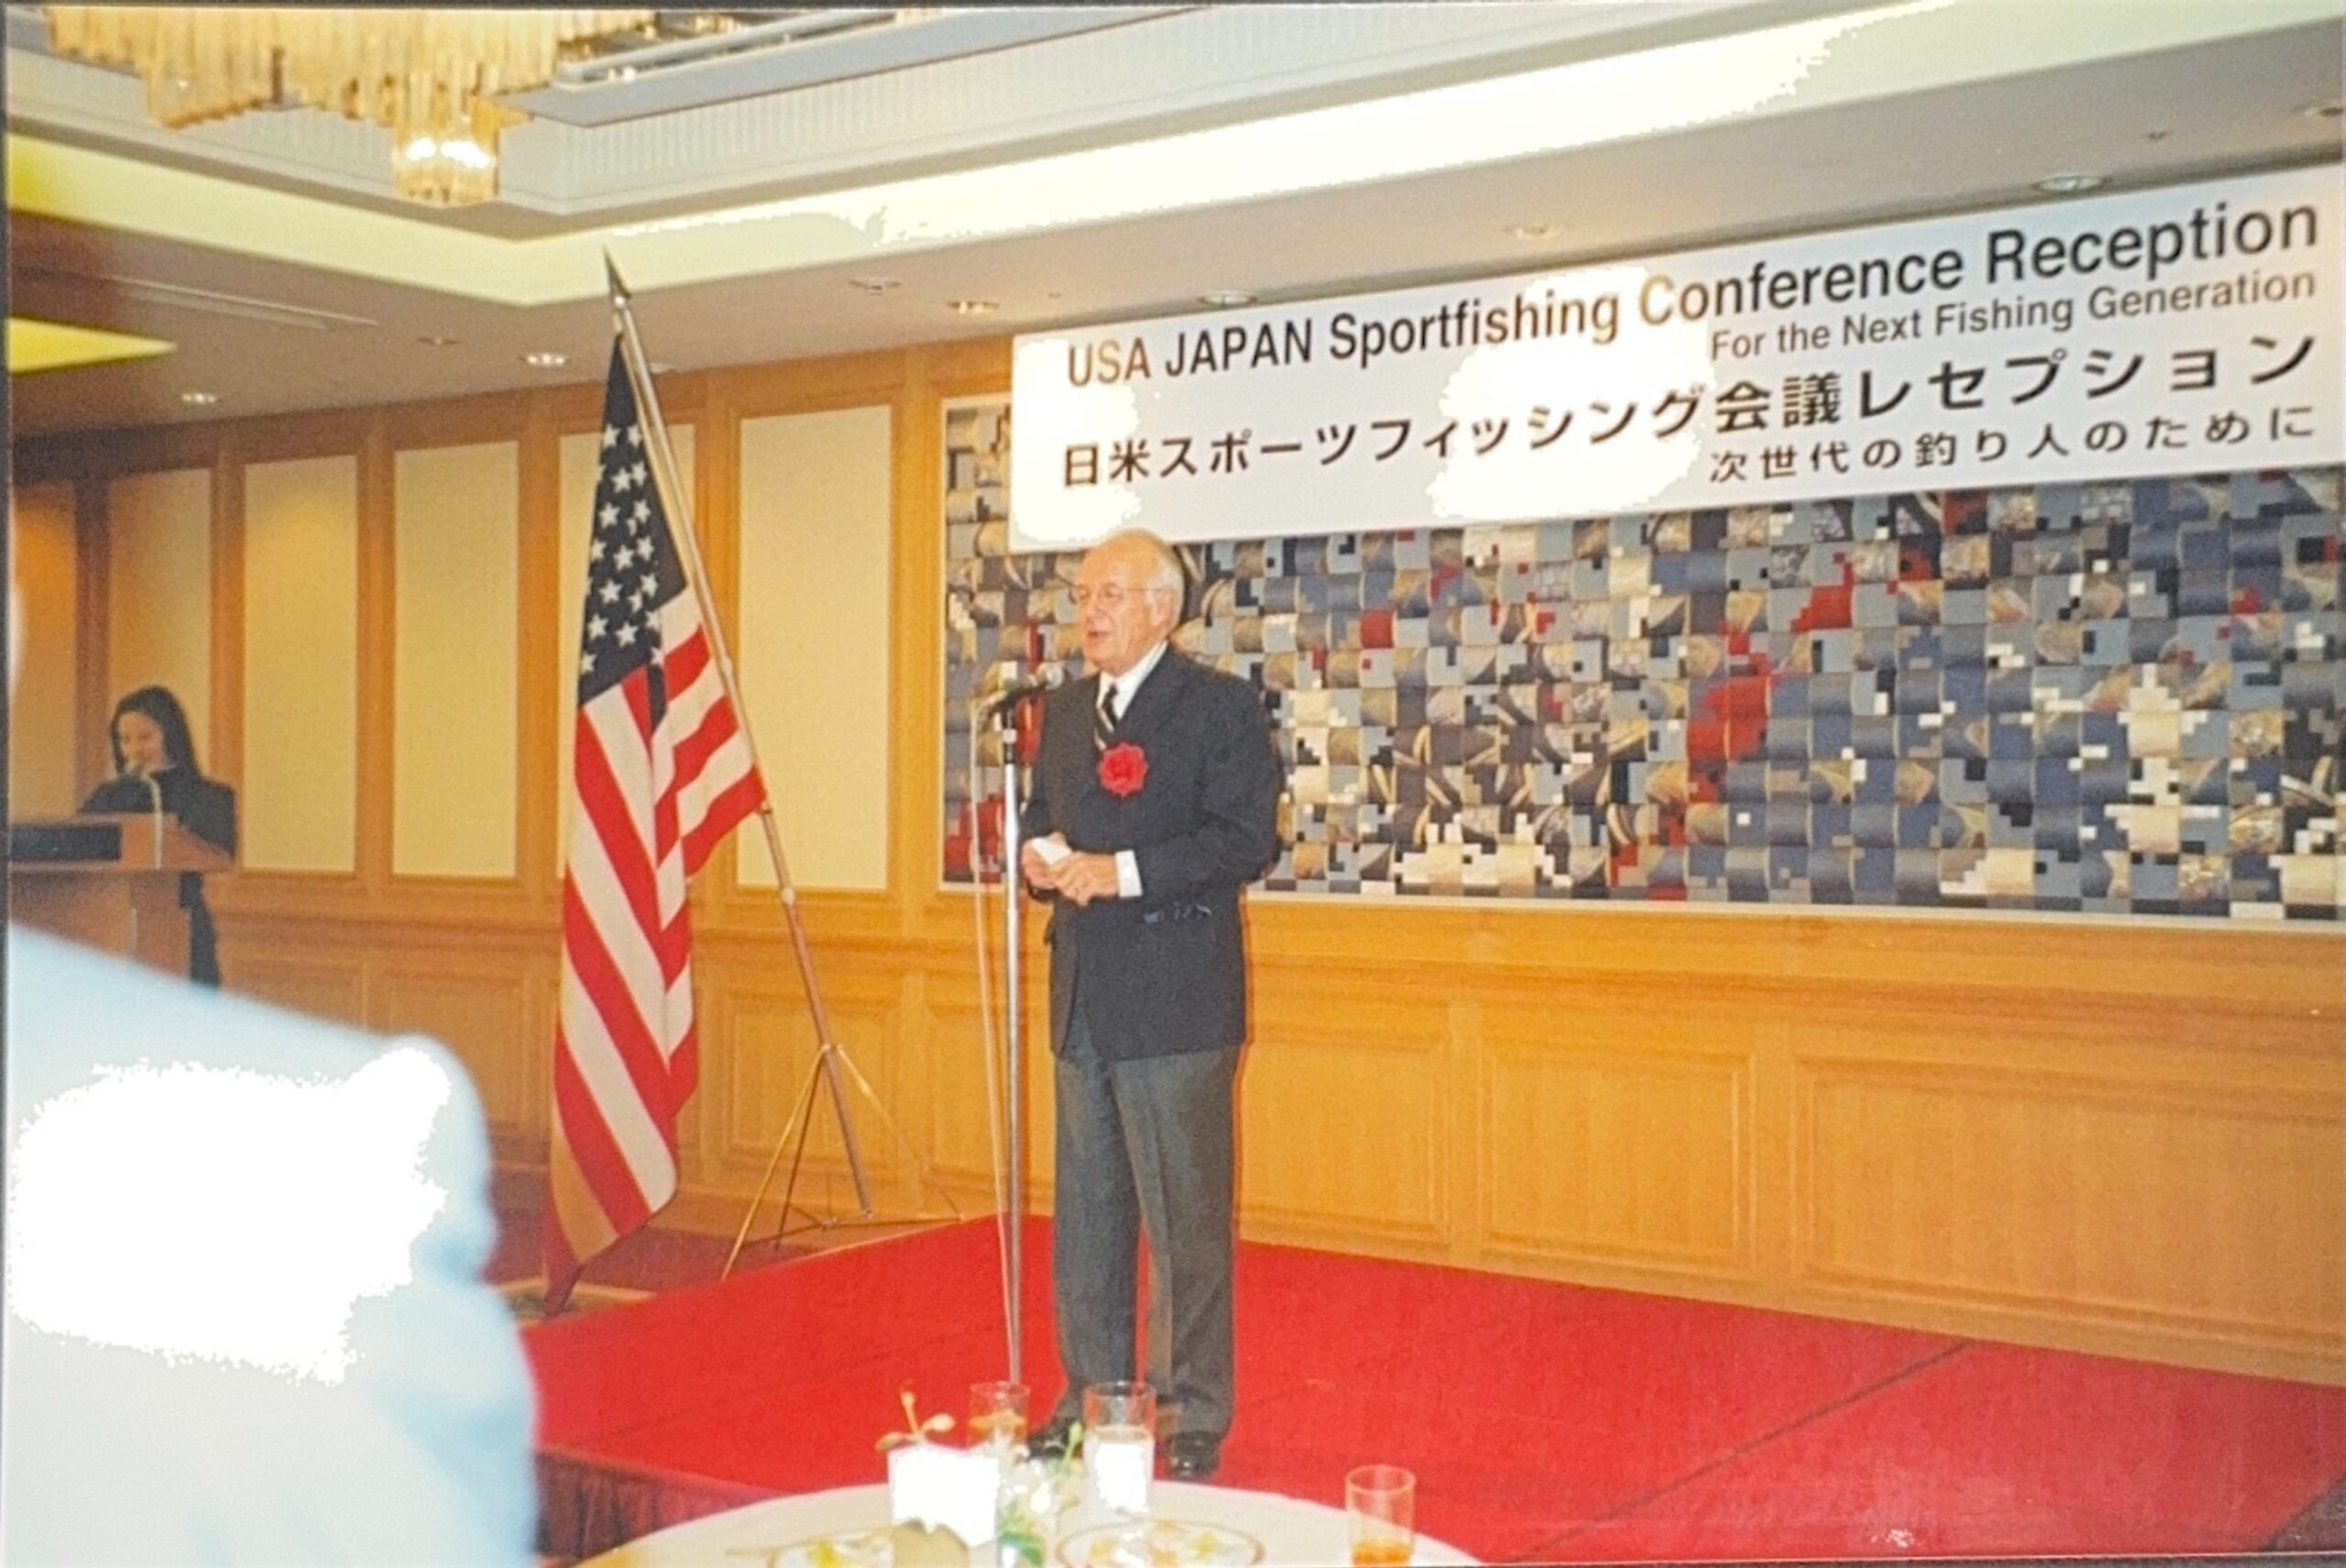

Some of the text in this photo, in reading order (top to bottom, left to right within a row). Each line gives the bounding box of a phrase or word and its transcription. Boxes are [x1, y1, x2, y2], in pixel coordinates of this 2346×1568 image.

[1068, 201, 2319, 387] USA JAPAN Sportfishing Conference Reception
[1710, 267, 2316, 362] For the Next Fishing Generation
[1062, 334, 2317, 488] 日米スポーツフィッシング会議レセプション
[1708, 404, 2317, 485] 次世代の釣り人のために
